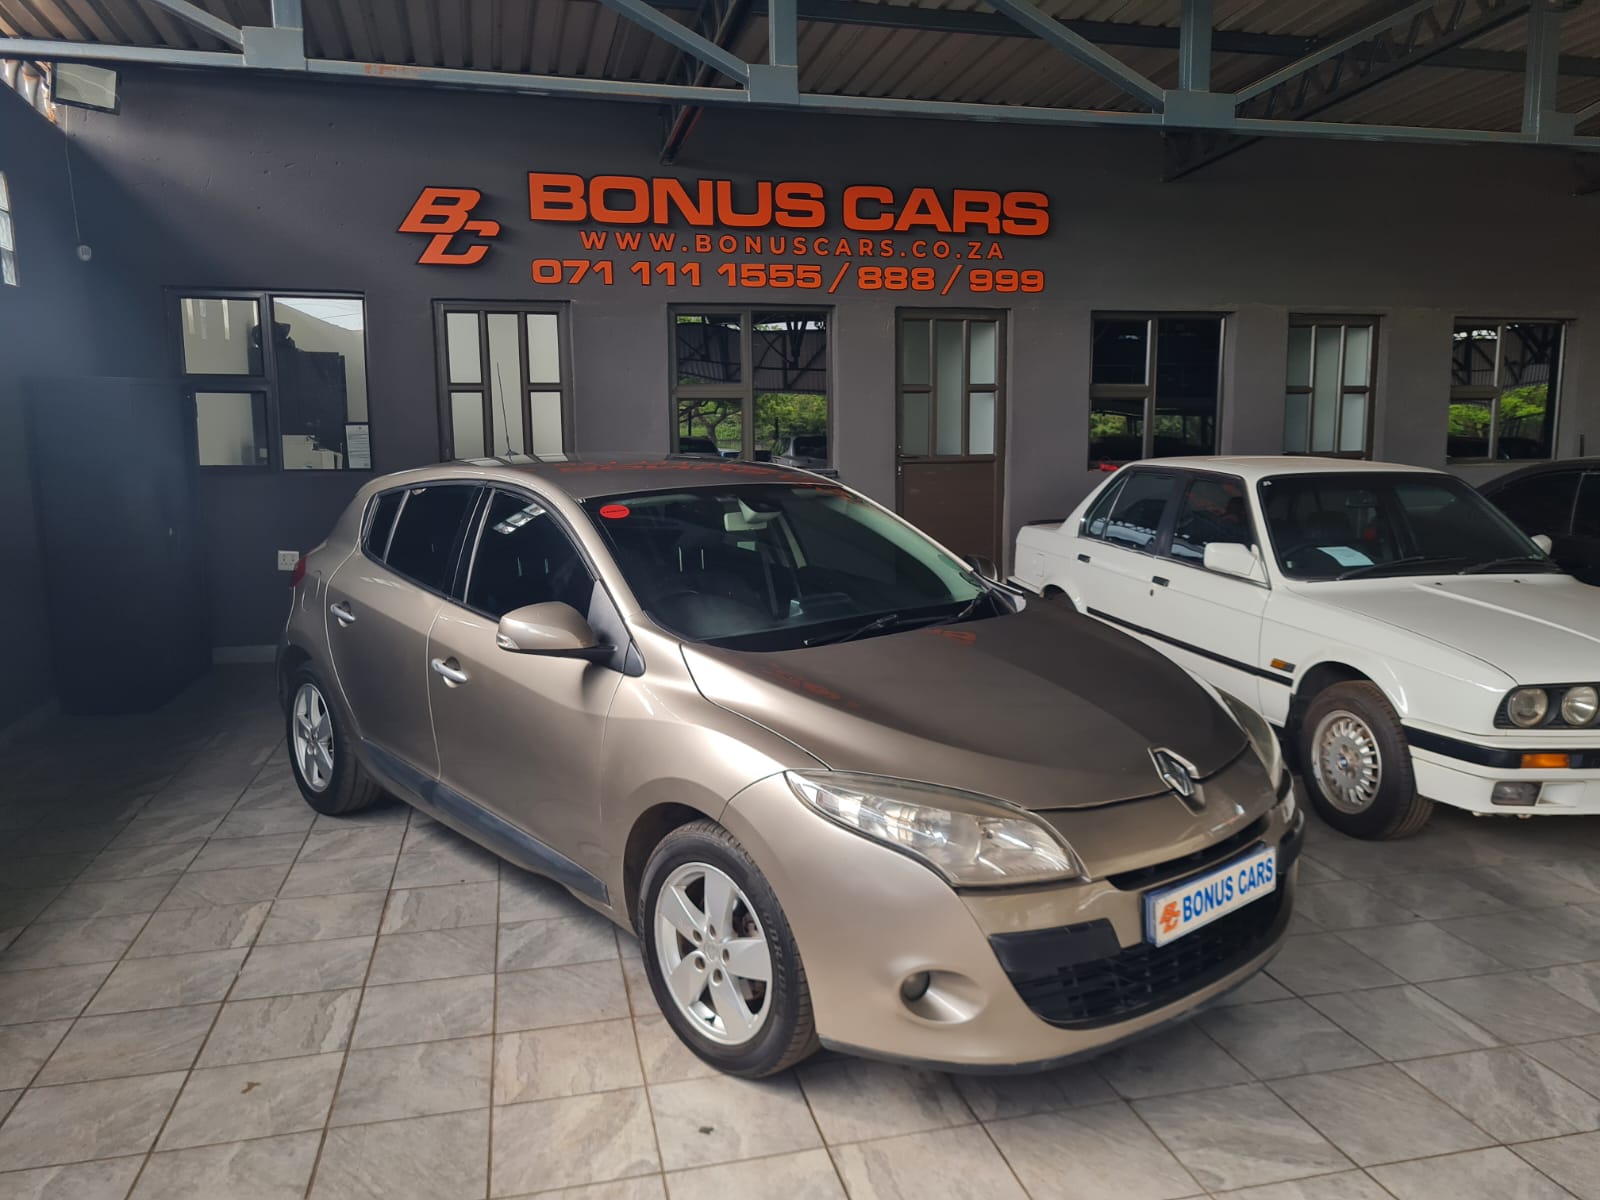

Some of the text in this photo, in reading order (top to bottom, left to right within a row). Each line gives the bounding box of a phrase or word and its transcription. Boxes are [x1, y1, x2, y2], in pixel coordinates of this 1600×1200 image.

[528, 172, 1051, 237] BONUS CARS
[579, 230, 1005, 260] WWW.BONUSCARS.CO.ZA
[531, 258, 614, 286] 071
[630, 260, 701, 287] 111
[1182, 875, 1234, 923] BONUS
[1237, 857, 1274, 895] CARS
